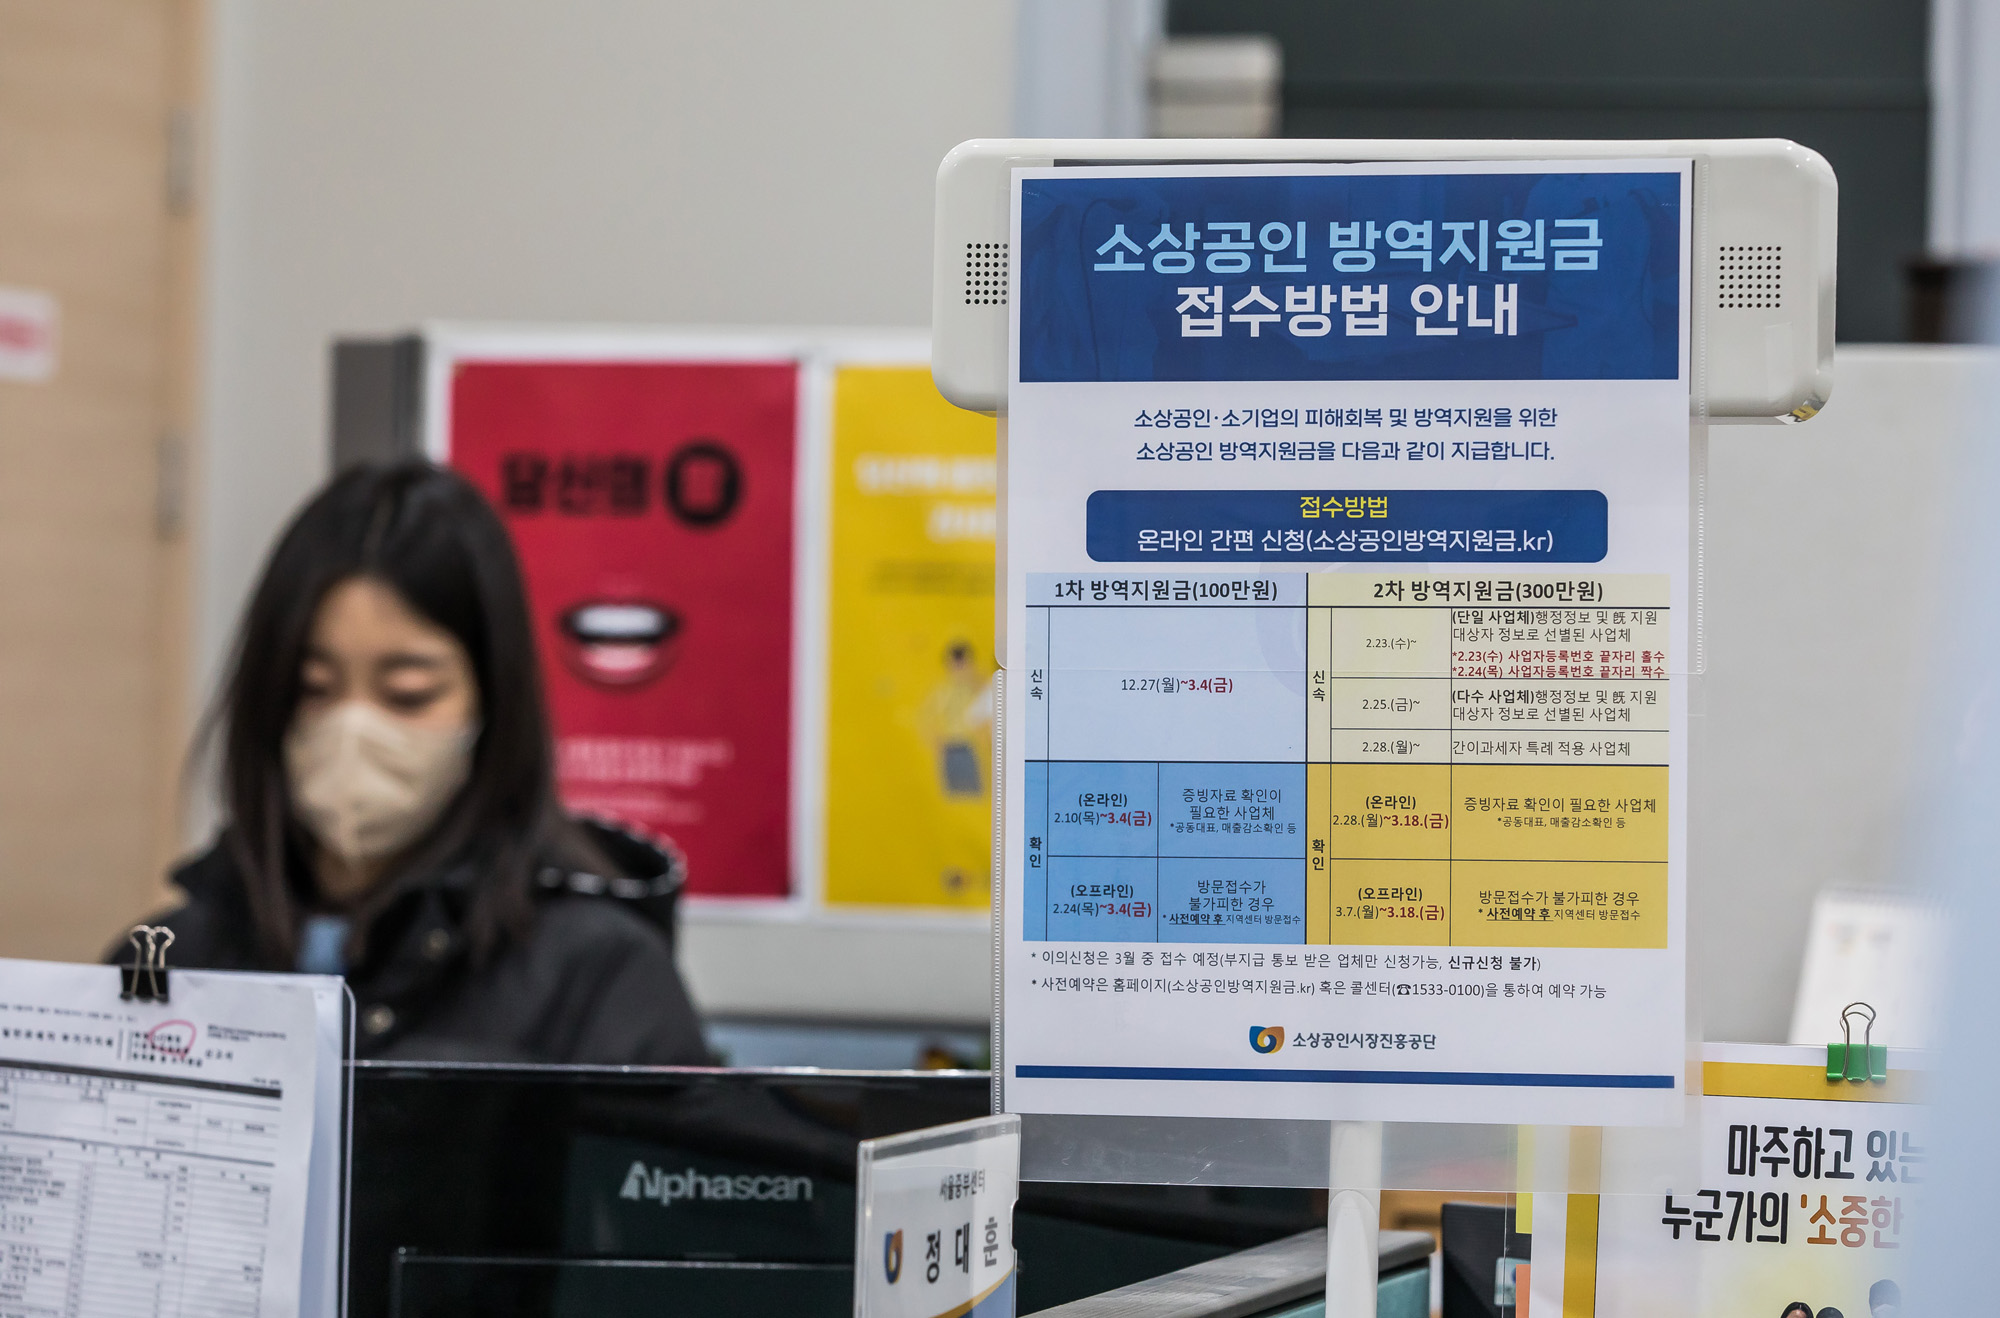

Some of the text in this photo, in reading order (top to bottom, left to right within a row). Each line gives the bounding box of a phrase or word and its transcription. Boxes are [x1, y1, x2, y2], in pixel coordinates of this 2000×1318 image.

[1094, 219, 1603, 274] 소상공인 방역지원금
[1175, 283, 1518, 338] 접수방법 안내
[1304, 408, 1382, 429] 피해회복
[1389, 408, 1407, 428] 및
[1414, 408, 1512, 429] 방역지원을
[1519, 408, 1557, 428] 위한
[1136, 441, 1555, 462] 소상공인 방역지원금을 다음과 같이 지급합니다.
[1299, 496, 1388, 519] 접수방법
[1137, 529, 1554, 554] 온라인 간편 신청(소상공인방역지원금.kr)
[1055, 580, 1278, 601] 1차 방역지원금(100만원)
[1374, 580, 1603, 602] 2차 방역지원금(300만원)
[1452, 610, 1484, 625] (단일
[1489, 610, 1591, 625] 사업체)행정정보
[1596, 610, 1608, 625] 및
[1630, 611, 1657, 625] 지원
[1453, 627, 1631, 642] 대상자 정보로 선별된 사업체
[1508, 650, 1594, 663] 사업자등록번호
[1600, 651, 1635, 663] 끝자리
[1641, 651, 1665, 664] 홀수
[1508, 665, 1594, 678] 사업자등록번호
[1600, 666, 1635, 678] 끝자리
[1641, 666, 1665, 678] 짝수
[1452, 690, 1484, 704] (다수
[1488, 690, 1591, 704] 사업체)행정정보
[1596, 690, 1608, 704] 및
[1630, 690, 1657, 705] 지원
[1453, 707, 1631, 722] 대상자 정보로 선별된 사업체
[1452, 741, 1631, 756] 간이과세자 특례 적용 사업체
[1078, 793, 1128, 807] (온라인)
[1182, 788, 1282, 803] 증빙자료 확인이
[1366, 795, 1416, 810] (온라인)
[1464, 797, 1656, 813] 증빙자료 확인이 필요한 사업체
[1189, 806, 1275, 820] 필요한 사업체
[1221, 823, 1284, 834] 매출감소확인
[1287, 823, 1296, 834] 등
[1550, 817, 1613, 828] 매출감소확인
[1616, 818, 1626, 828] 등
[1071, 884, 1134, 899] (오프라인)
[1197, 880, 1266, 895] 방문접수가
[1358, 887, 1423, 901] (오프라인)
[1189, 897, 1275, 911] 불가피한 경우
[1480, 890, 1640, 906] 방문접수가 불가피한 경우
[1169, 913, 1301, 925] 사전예약 후 지역센터 방문접수
[1487, 908, 1640, 921] 사전예약 후 지역센터 방문접수
[1042, 950, 1541, 971] 이의신청은 3월 중 접수 예정(부지급 통보 받은 업체만 신청가능, 신규신청 불가)
[1042, 977, 1109, 992] 사전예약은
[1113, 978, 1315, 995] 홈페이지(소상공인방역지원금.kr)
[1319, 981, 1345, 995] 혹은
[1503, 983, 1544, 998] 통하여
[1549, 984, 1575, 998] 예약
[1580, 984, 1607, 998] 가능
[1292, 1032, 1436, 1050] 소상공인시장진흥공단
[1728, 1125, 1855, 1180] 마주하고
[620, 1161, 813, 1205] Alphascan
[1662, 1189, 1789, 1244] 누군가의
